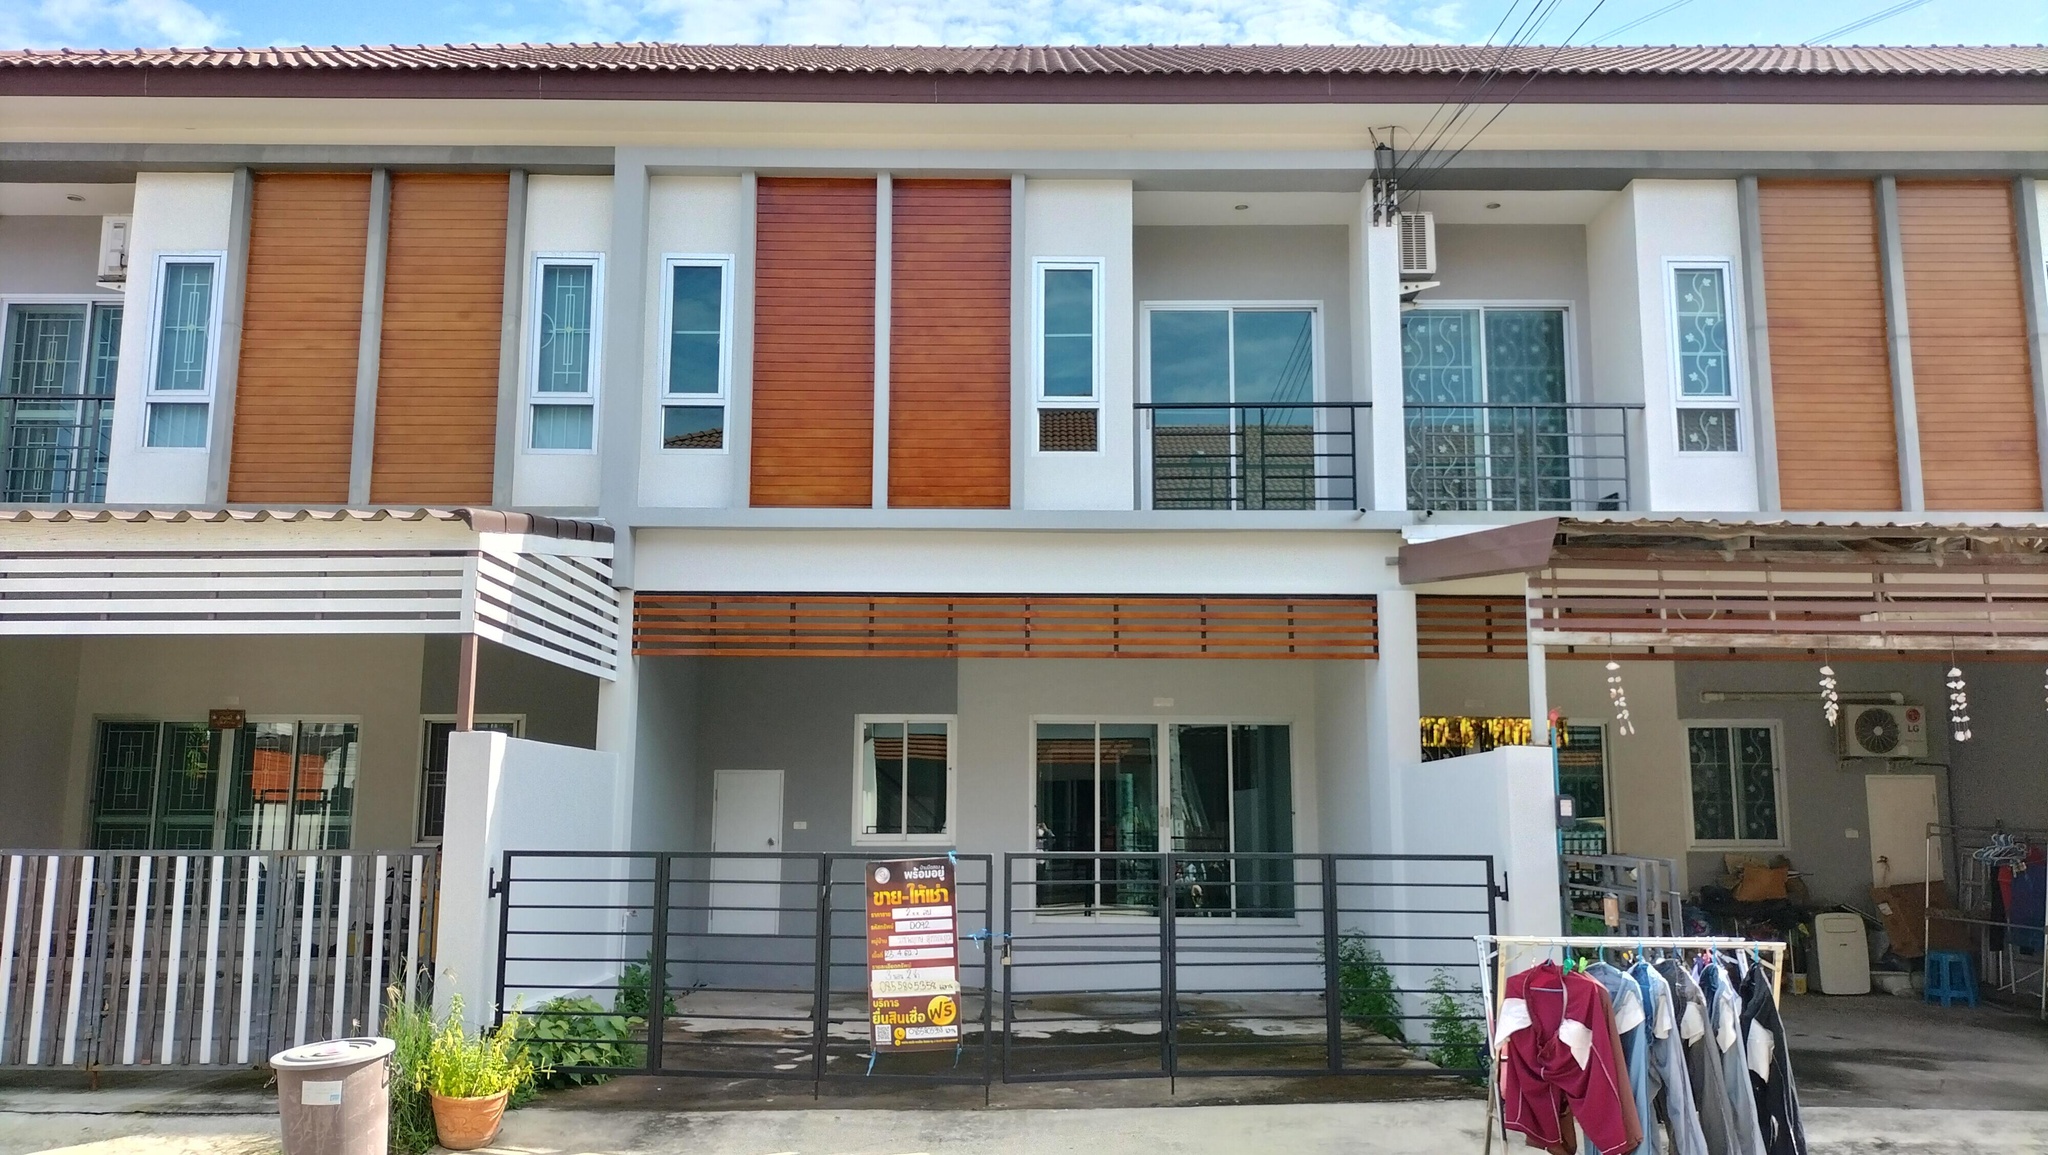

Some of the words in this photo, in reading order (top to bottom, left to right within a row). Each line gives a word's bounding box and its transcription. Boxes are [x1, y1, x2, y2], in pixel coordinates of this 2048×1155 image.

[1907, 725, 1920, 733] LG
[903, 865, 945, 881] พร้อมอยู่
[873, 883, 949, 906] ขาย-ให้เช่า
[872, 998, 900, 1008] บริการ
[929, 1000, 953, 1020] ฟรี
[872, 1006, 926, 1024] ยื่นสินเชื่อ
